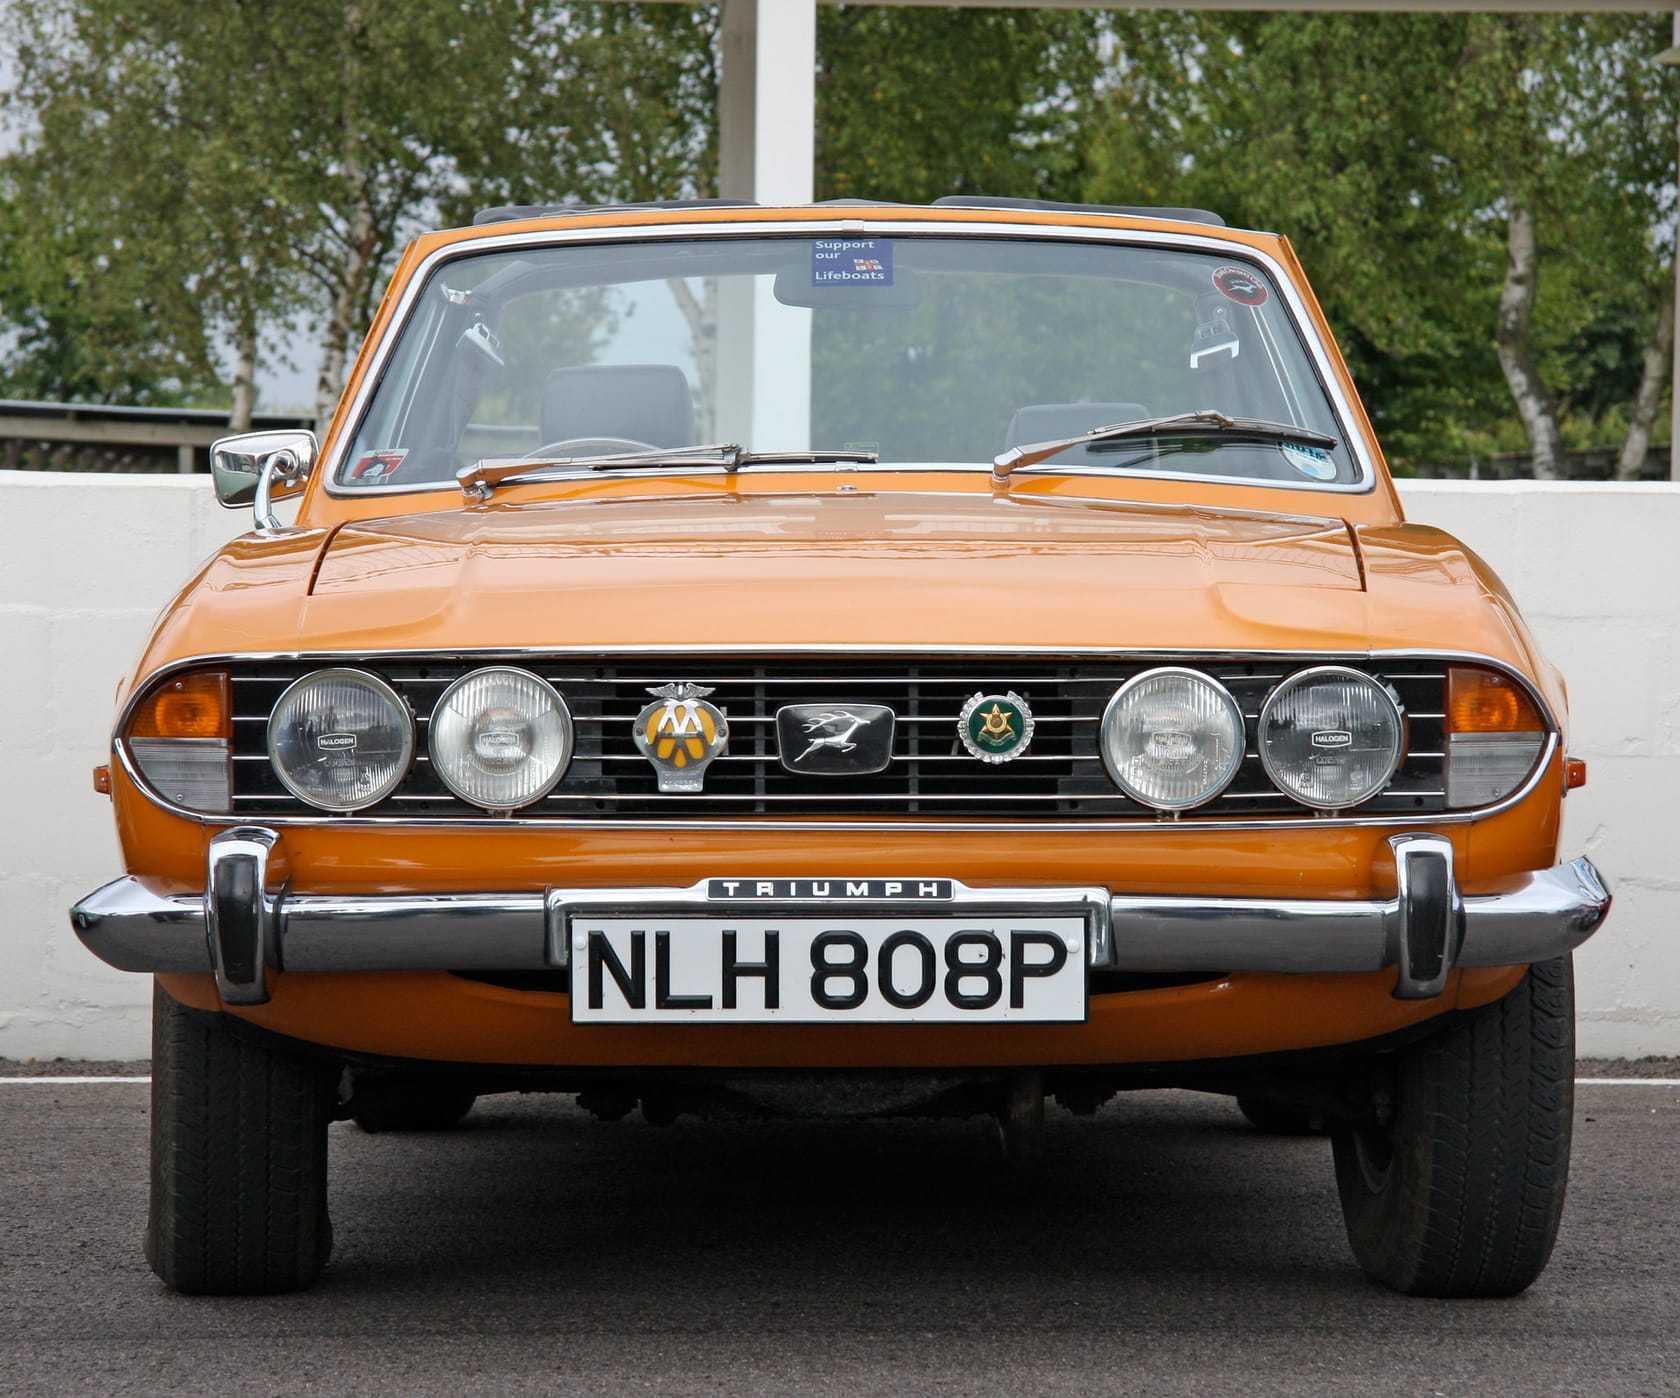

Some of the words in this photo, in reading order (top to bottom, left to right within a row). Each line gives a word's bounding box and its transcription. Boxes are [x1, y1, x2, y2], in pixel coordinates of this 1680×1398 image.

[815, 240, 875, 251] Support
[815, 271, 885, 280] Lifeboats
[1315, 735, 1349, 743] HALOGEN
[722, 882, 938, 897] TRIUMPH
[588, 930, 780, 1010] NLH
[810, 929, 1068, 1010] 808P
